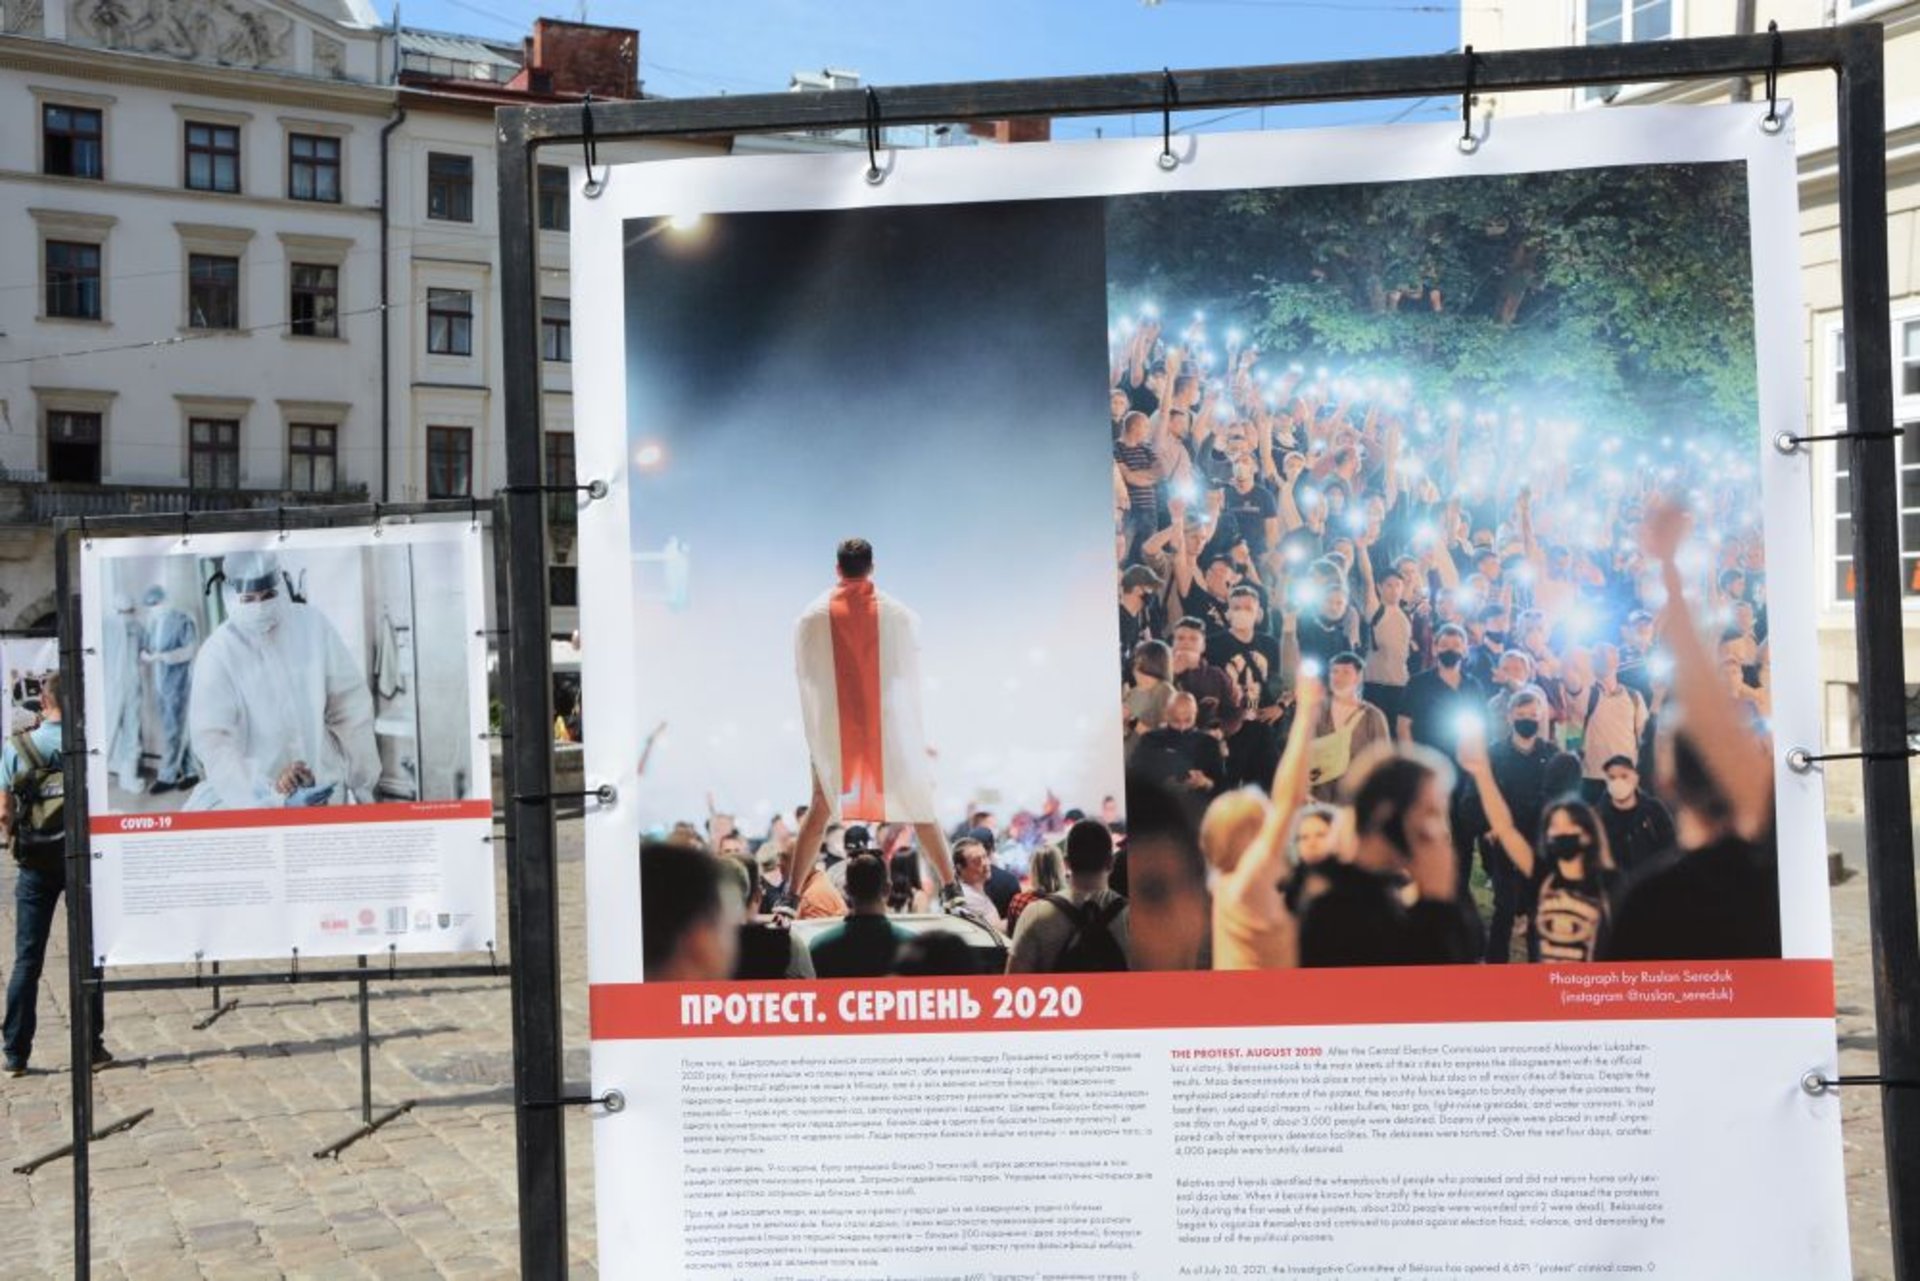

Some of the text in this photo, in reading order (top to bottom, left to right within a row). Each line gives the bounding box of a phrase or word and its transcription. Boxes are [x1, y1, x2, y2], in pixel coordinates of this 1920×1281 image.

[120, 816, 172, 830] COVID-19
[1550, 969, 1732, 987] Photograph by Ruslan Sereduk
[1561, 987, 1734, 1005] (instagram @ruslan_sereduk)
[680, 986, 1083, 1025] ПРОТЕСТ. СЕРПЕНЬ 2020
[1172, 1049, 1191, 1059] THE
[1193, 1049, 1243, 1059] PROTEST.
[1246, 1048, 1293, 1058] AUGUST
[1295, 1047, 1323, 1057] 2020
